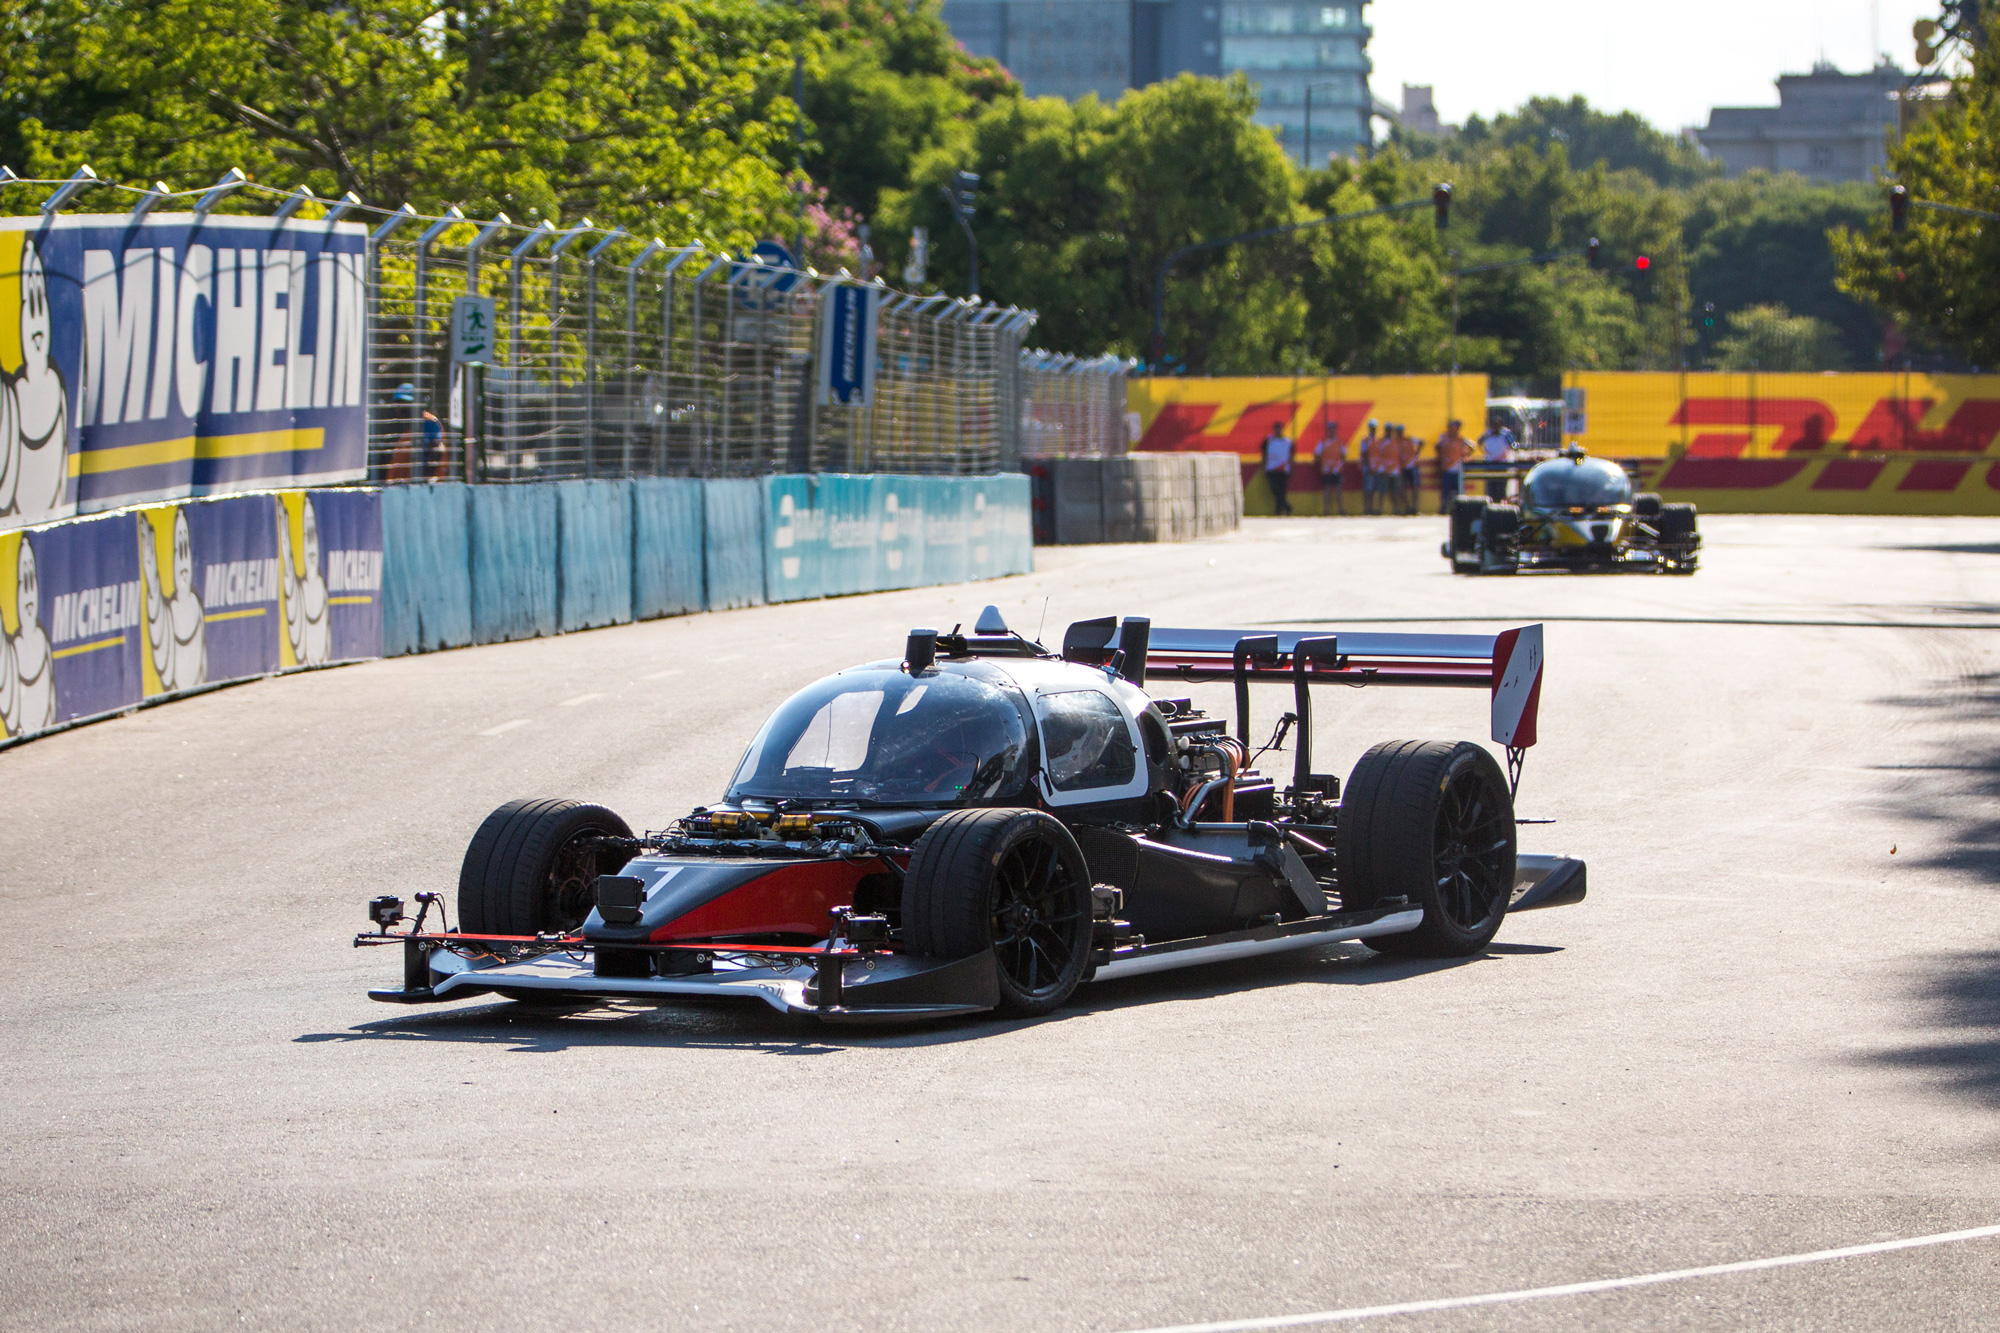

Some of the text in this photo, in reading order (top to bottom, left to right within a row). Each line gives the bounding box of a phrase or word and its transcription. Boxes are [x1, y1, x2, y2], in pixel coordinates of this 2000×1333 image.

[75, 243, 364, 428] MICHELIN
[1657, 398, 2000, 491] DH
[204, 558, 279, 608] MICHELIN
[328, 551, 383, 592] MICHELIN
[53, 581, 141, 644] MICHELIN
[646, 866, 686, 902] 7
